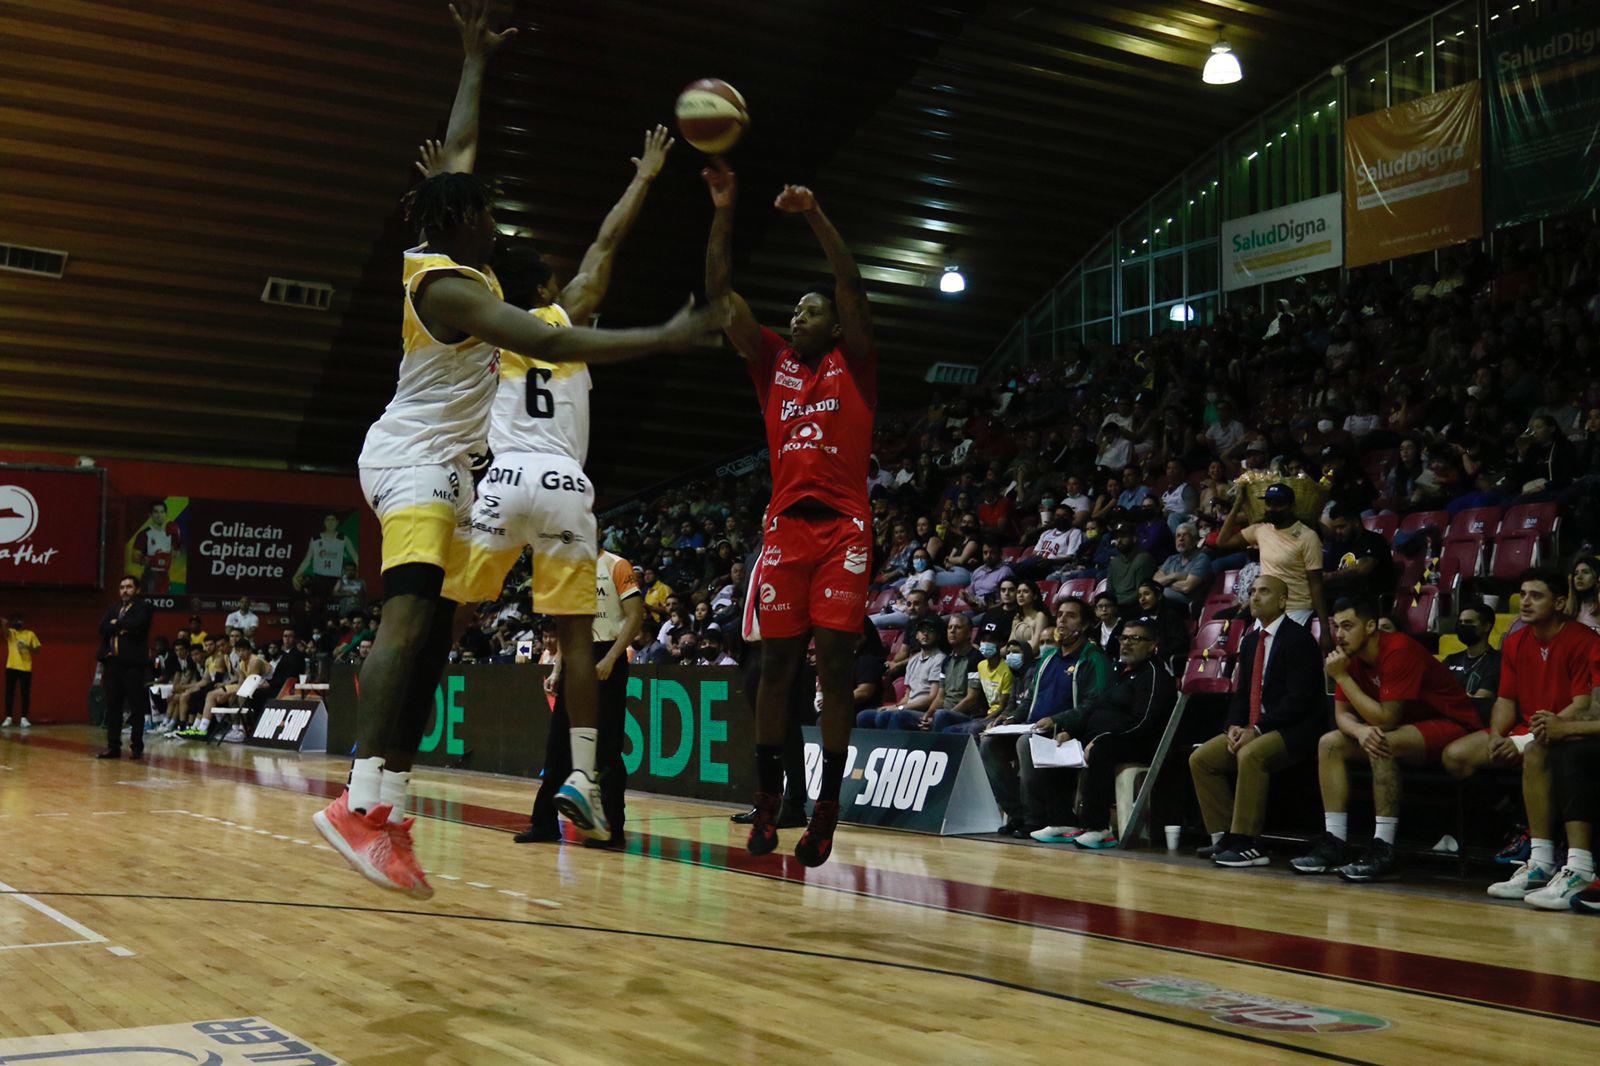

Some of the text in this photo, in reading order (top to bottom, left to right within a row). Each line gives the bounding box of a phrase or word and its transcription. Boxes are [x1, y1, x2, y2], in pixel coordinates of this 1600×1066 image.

[1356, 143, 1465, 186] SaludDigna
[1232, 217, 1326, 252] SaludDigna
[525, 367, 554, 419] 6
[487, 466, 586, 493] oni Gas
[209, 521, 282, 540] Culiacán
[12, 544, 59, 566] Hut
[199, 540, 293, 560] Capital del
[211, 560, 284, 580] Deporte
